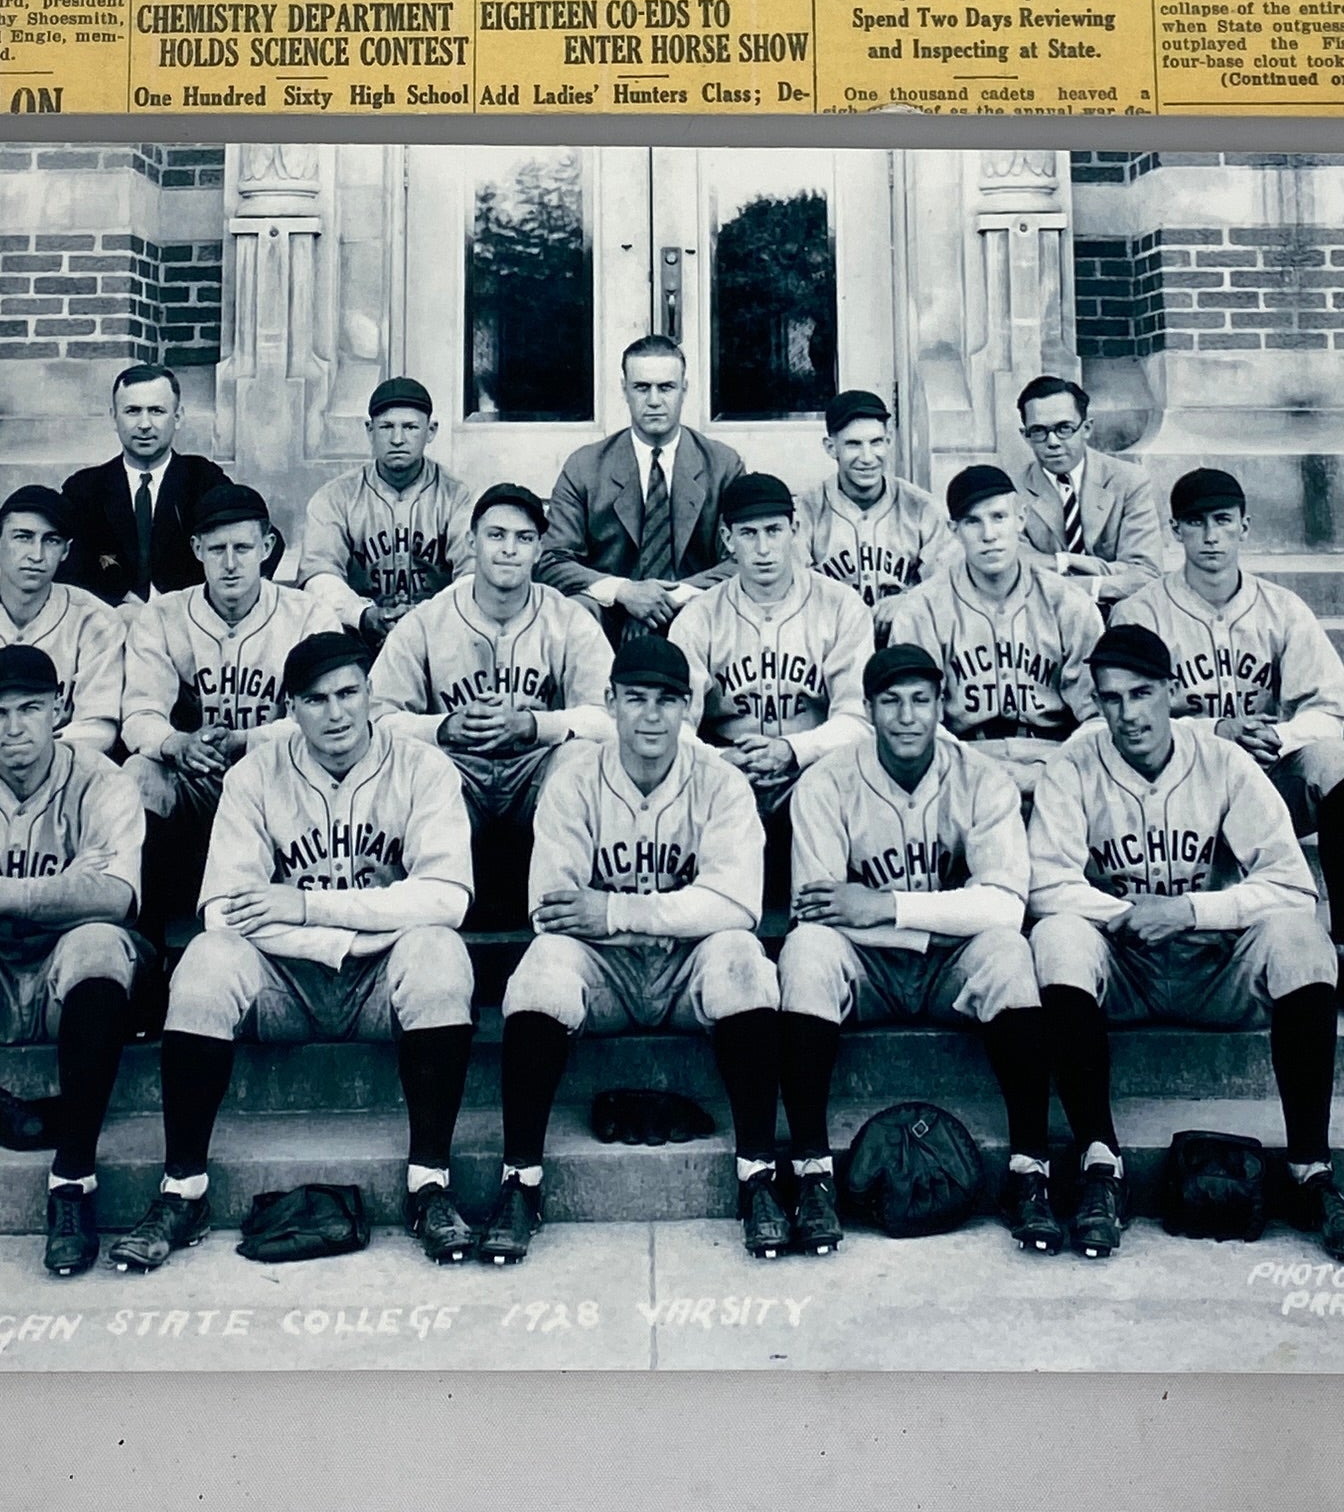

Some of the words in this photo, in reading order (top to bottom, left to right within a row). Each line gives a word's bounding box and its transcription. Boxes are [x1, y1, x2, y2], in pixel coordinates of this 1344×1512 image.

[136, 2, 278, 35] CHEMISTRY
[287, 1, 454, 33] DEPARTMENT
[479, 0, 598, 31] EIGHTEEN
[851, 6, 910, 33] Spend
[916, 6, 959, 28] Two
[965, 6, 1013, 32] Days
[1018, 7, 1117, 32] Reviewing
[158, 37, 240, 68] HOLDS
[250, 36, 350, 67] SCIENCE
[359, 35, 470, 67] CONTEST
[563, 34, 644, 66] ENTER
[650, 33, 732, 65] HORSE
[738, 31, 810, 64] SHOW
[867, 38, 903, 60] and
[912, 38, 1010, 64] Inspecting
[1018, 41, 1039, 59] at
[1047, 37, 1102, 59] State.
[1162, 54, 1244, 69] four-base
[1253, 54, 1297, 69] clout
[732, 691, 807, 723] STATE
[107, 1309, 255, 1337] STATE
[281, 1302, 463, 1340] COLLEGE
[499, 1300, 602, 1333] 1928
[636, 1294, 813, 1329] VARSITY
